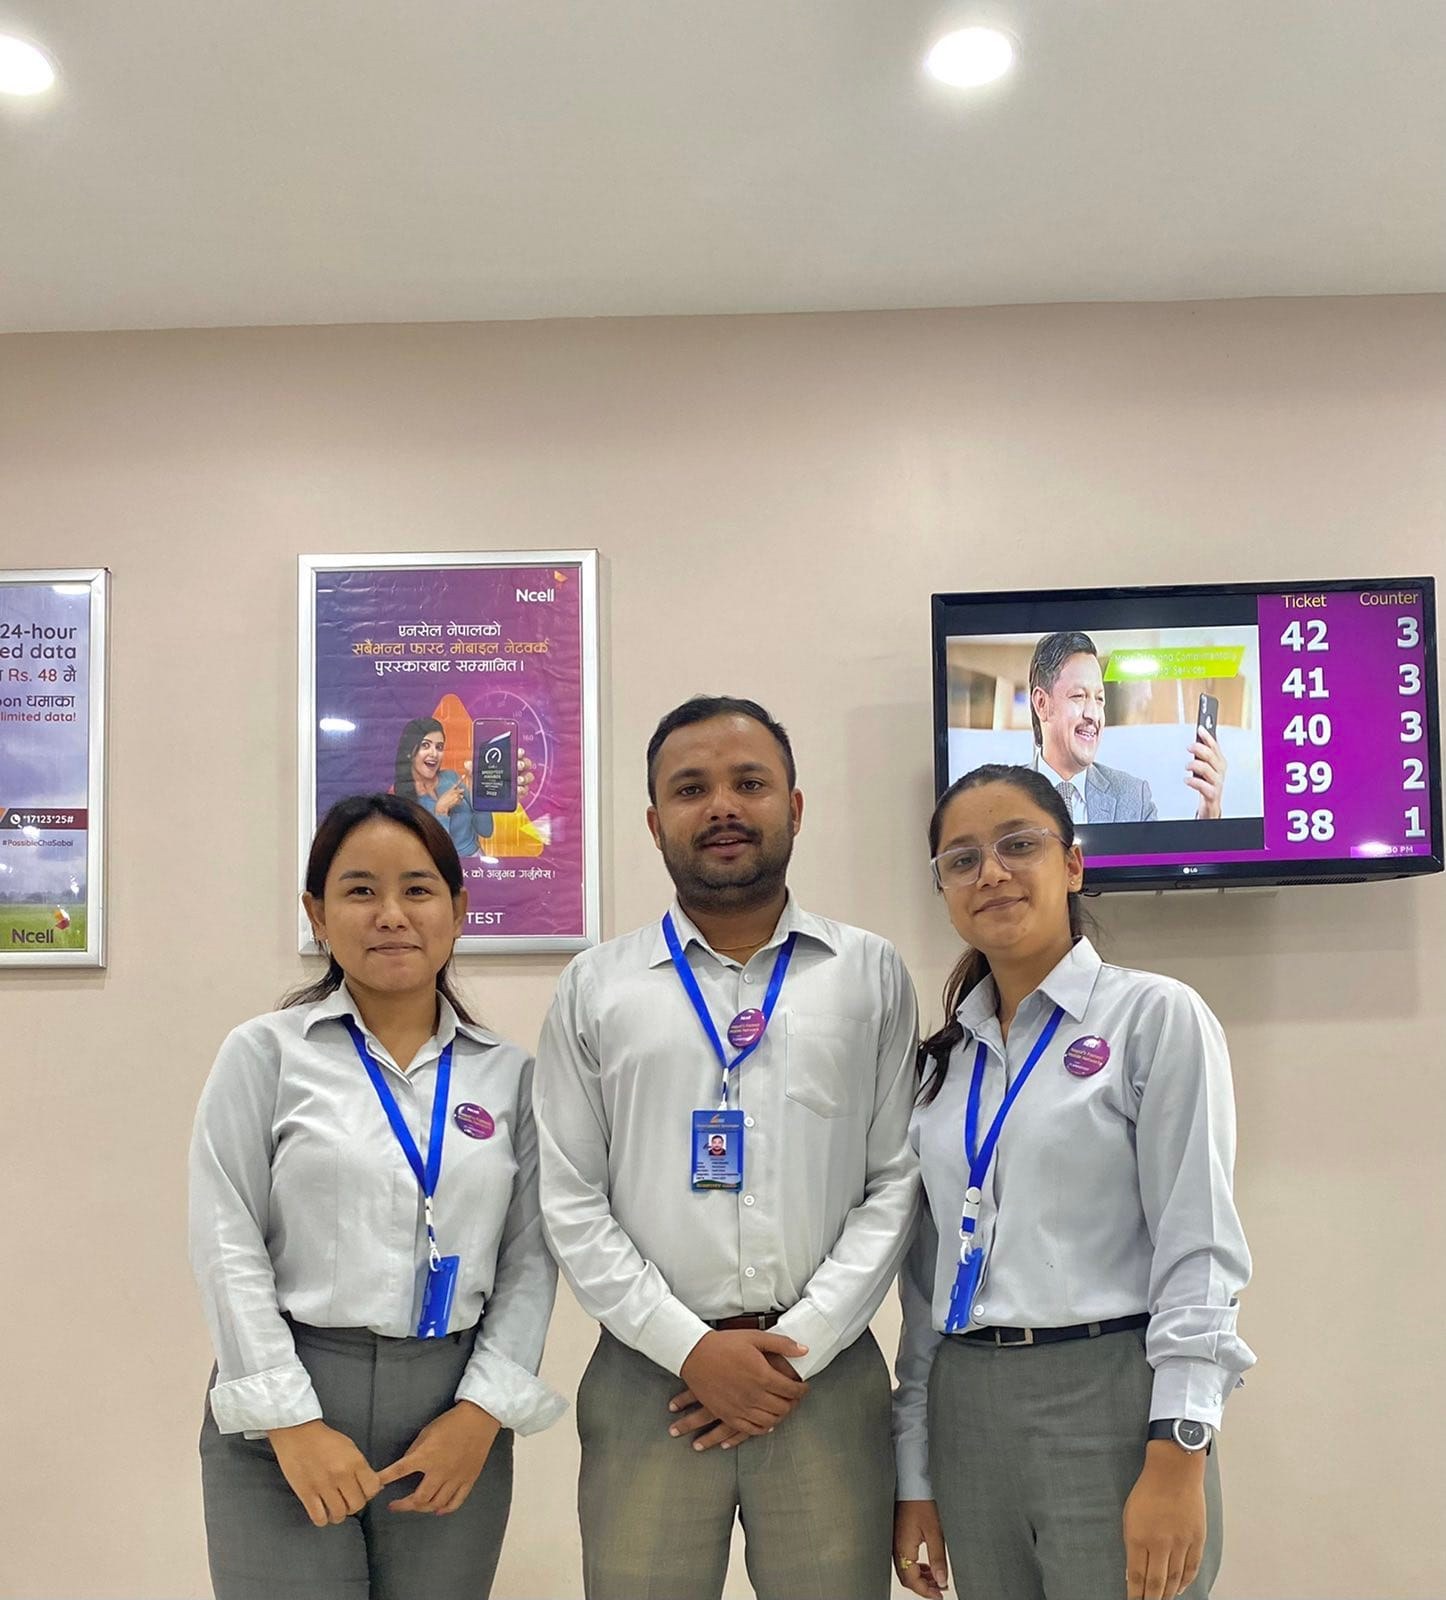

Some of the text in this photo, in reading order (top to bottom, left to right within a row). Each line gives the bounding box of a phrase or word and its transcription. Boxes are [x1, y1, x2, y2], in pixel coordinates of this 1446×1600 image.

[516, 588, 554, 602] Ncell
[1281, 594, 1327, 608] Ticket
[1359, 592, 1418, 606] Counter
[0, 623, 77, 640] 24-hour
[398, 620, 502, 637] एनसेल नेपालको
[1280, 619, 1329, 652] 42
[1397, 616, 1419, 648] 3
[30, 643, 76, 659] data
[450, 639, 499, 655] मोबाइल
[504, 637, 549, 655] नेटवर्क
[8, 668, 32, 682] Rs.
[38, 668, 57, 682] 48
[375, 660, 451, 676] पुरस्कारबाट
[1281, 667, 1330, 699] 41
[1398, 663, 1421, 696] 3
[26, 694, 76, 707] धमाका
[44, 711, 76, 722] data!
[1283, 713, 1332, 746] 40
[1400, 711, 1423, 743] 3
[1285, 760, 1333, 794] 39
[1402, 758, 1425, 790] 2
[1286, 809, 1335, 842] 38
[1404, 806, 1426, 838] 1
[466, 912, 503, 924] TEST
[11, 929, 54, 943] Ncell
